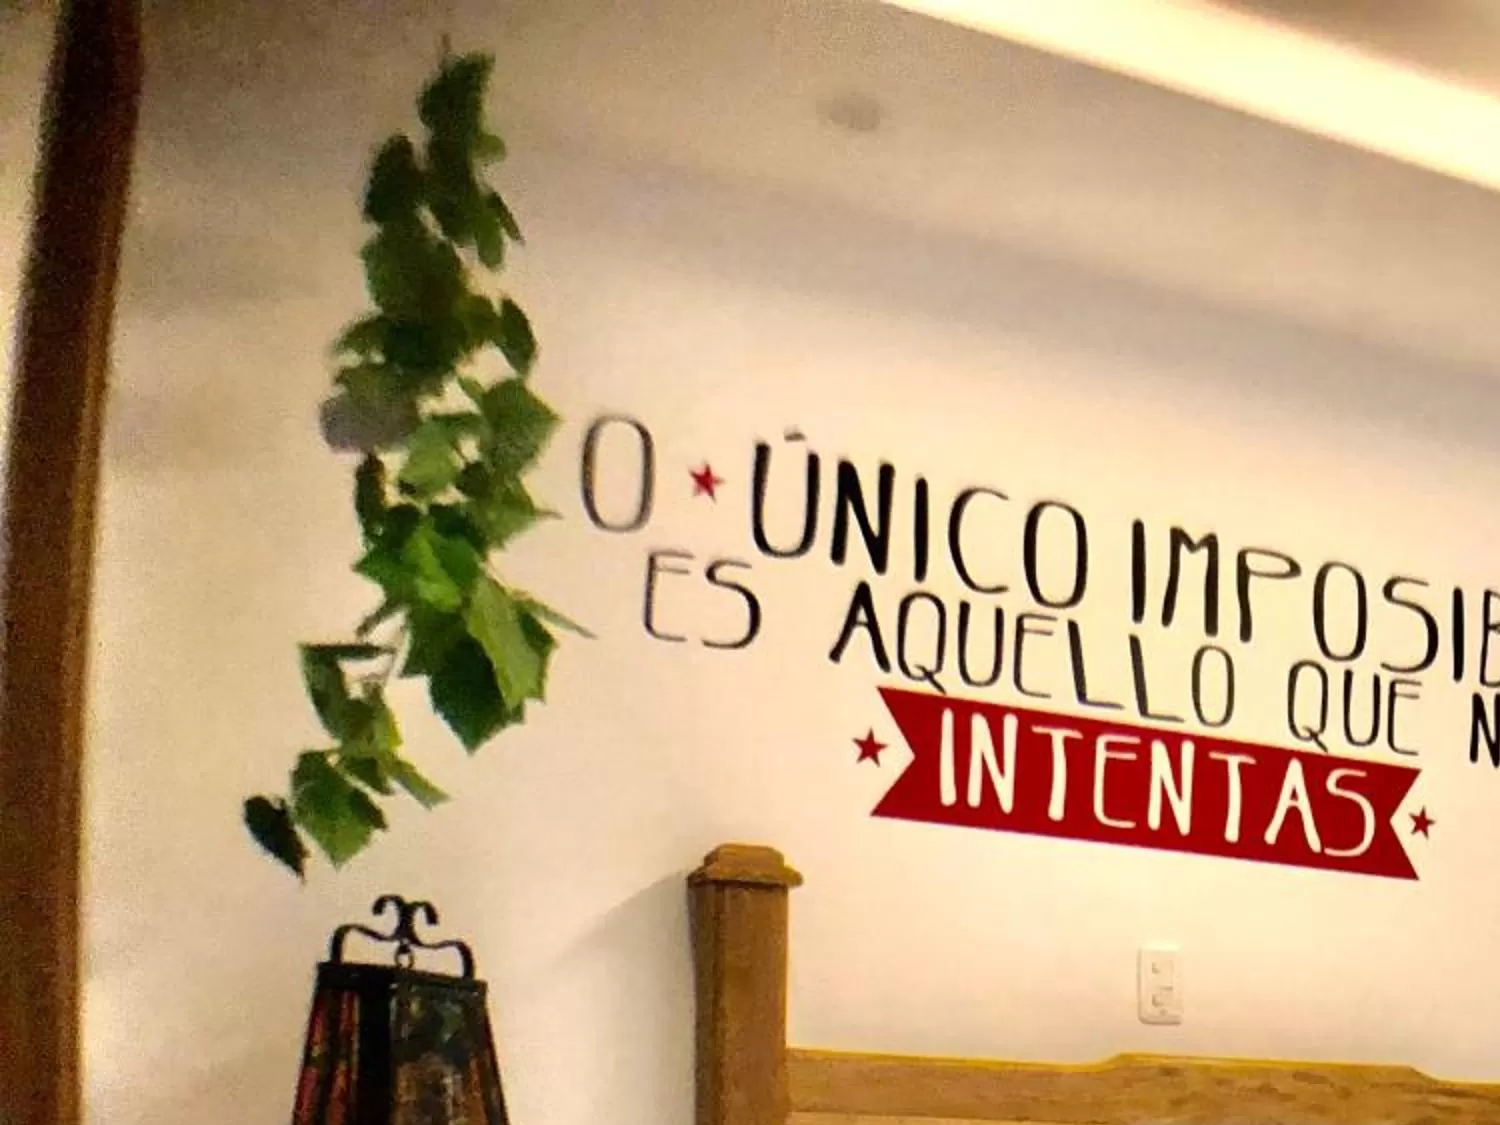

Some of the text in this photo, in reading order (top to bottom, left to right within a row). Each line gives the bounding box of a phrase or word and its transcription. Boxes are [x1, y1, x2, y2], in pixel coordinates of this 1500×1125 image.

[750, 428, 1090, 610] ÚNICO
[642, 549, 762, 649] ES
[828, 579, 1236, 728] AQUELLO
[1287, 661, 1422, 755] QUE
[938, 707, 1376, 858] INTENTAS
